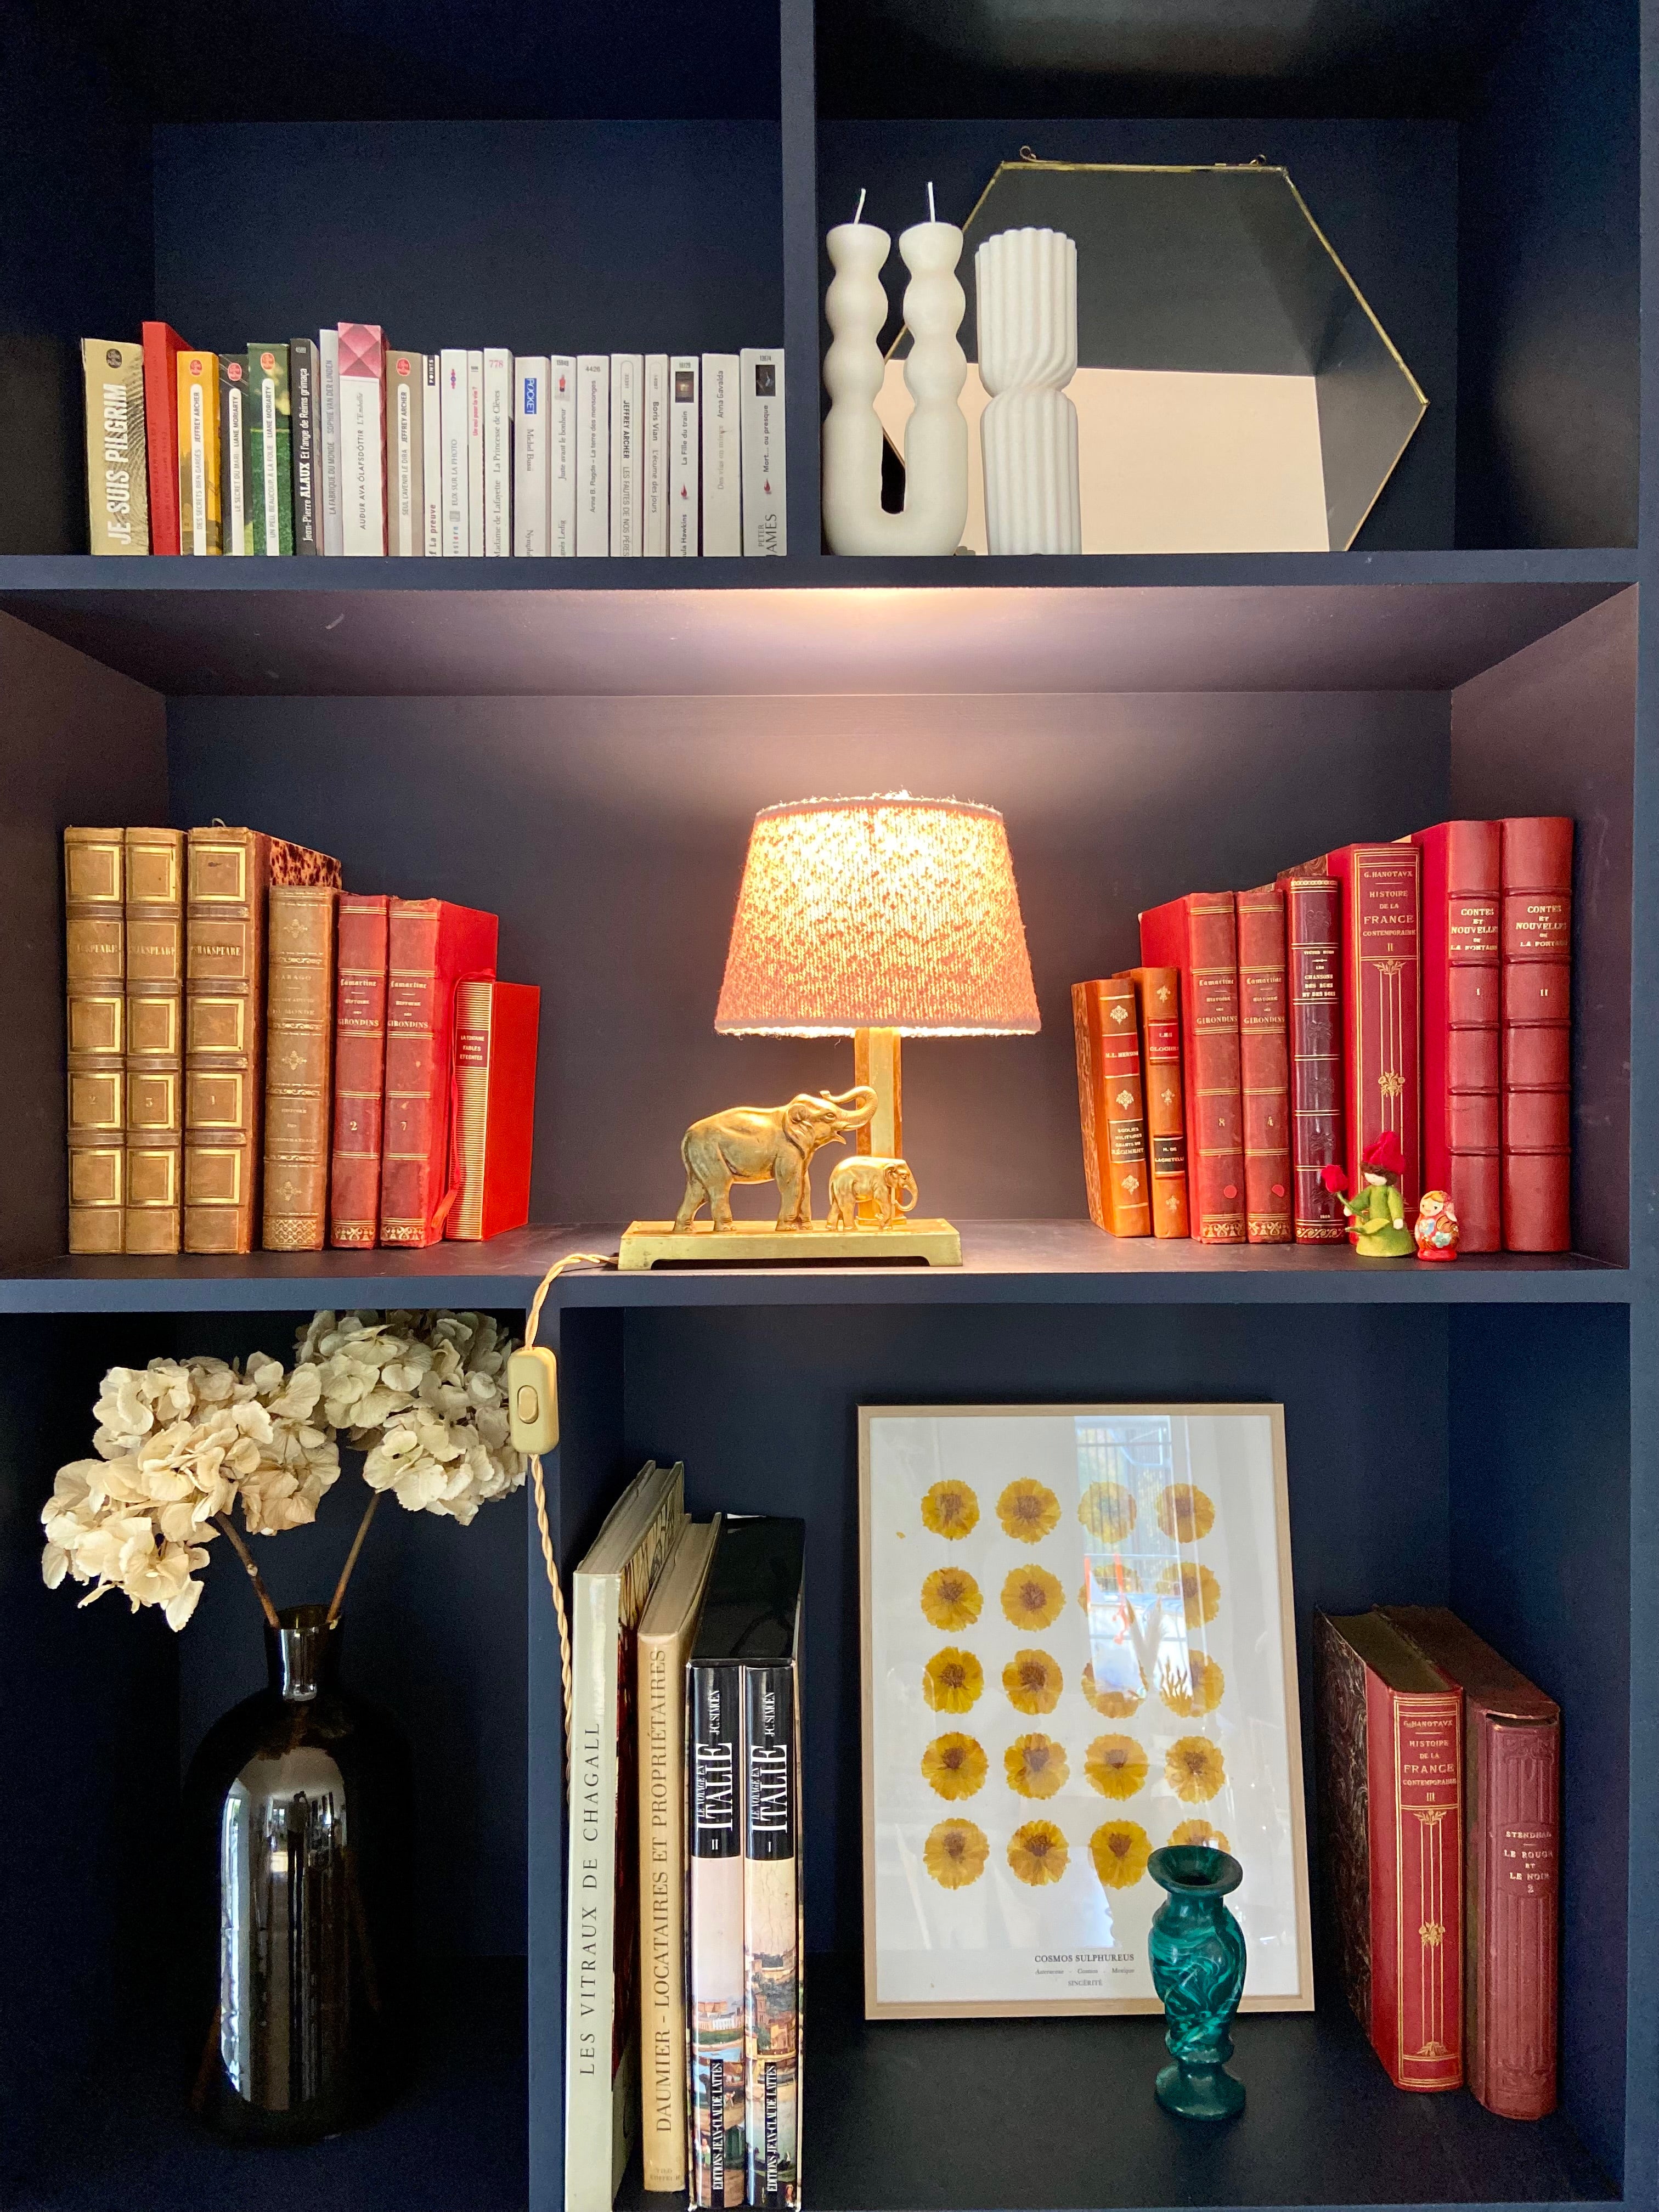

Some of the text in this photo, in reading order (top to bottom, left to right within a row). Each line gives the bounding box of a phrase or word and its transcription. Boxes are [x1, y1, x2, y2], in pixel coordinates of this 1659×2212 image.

[299, 369, 309, 396] grimaça
[525, 379, 537, 414] POCKET
[300, 398, 308, 418] Reims
[300, 420, 308, 428] de
[493, 415, 500, 425] de
[681, 430, 687, 438] du
[300, 430, 311, 449] l'ange
[764, 436, 769, 445] ou
[103, 384, 131, 544] JE SUIS PILGRIM
[494, 462, 500, 472] La
[328, 466, 335, 474] DU
[451, 467, 457, 475] LA
[558, 465, 567, 480] Juste
[300, 463, 311, 498] ALAUX
[329, 477, 337, 505] FABRIQUE
[493, 481, 502, 514] Lafayette
[623, 508, 629, 517] DE
[302, 500, 313, 541] Jean-Pierre
[494, 515, 500, 524] de
[269, 529, 275, 538] UN
[557, 520, 566, 539] Ledig
[430, 538, 436, 547] La
[1527, 905, 1561, 913] CONTES
[1364, 915, 1413, 924] FRANCE
[1388, 943, 1393, 951] II
[1197, 1015, 1238, 1024] GIRONDINS
[146, 1097, 153, 1107] 3
[350, 1121, 357, 1130] 2
[1219, 1118, 1224, 1126] 8
[1404, 1764, 1454, 1773] FRANCE
[696, 1742, 732, 1831] ITALIE
[697, 1765, 706, 1817] LE VOYAGE EN
[751, 1745, 787, 1833] ITALIE
[751, 1767, 760, 1820] LE VOYAGE EN
[1426, 1792, 1435, 1801] III
[712, 1839, 718, 1850] II
[1504, 1849, 1516, 1858] LE
[646, 1650, 672, 2132] DAUMIER LOCATAIRES ET PROPRIÉTAIRES
[1527, 1884, 1534, 1893] 2
[579, 1723, 599, 2075] LES VITRAUX DE CHAGALL
[713, 2096, 723, 2151] JEAN-CLAUDE
[768, 2098, 777, 2154] JEAN-CLAUDE
